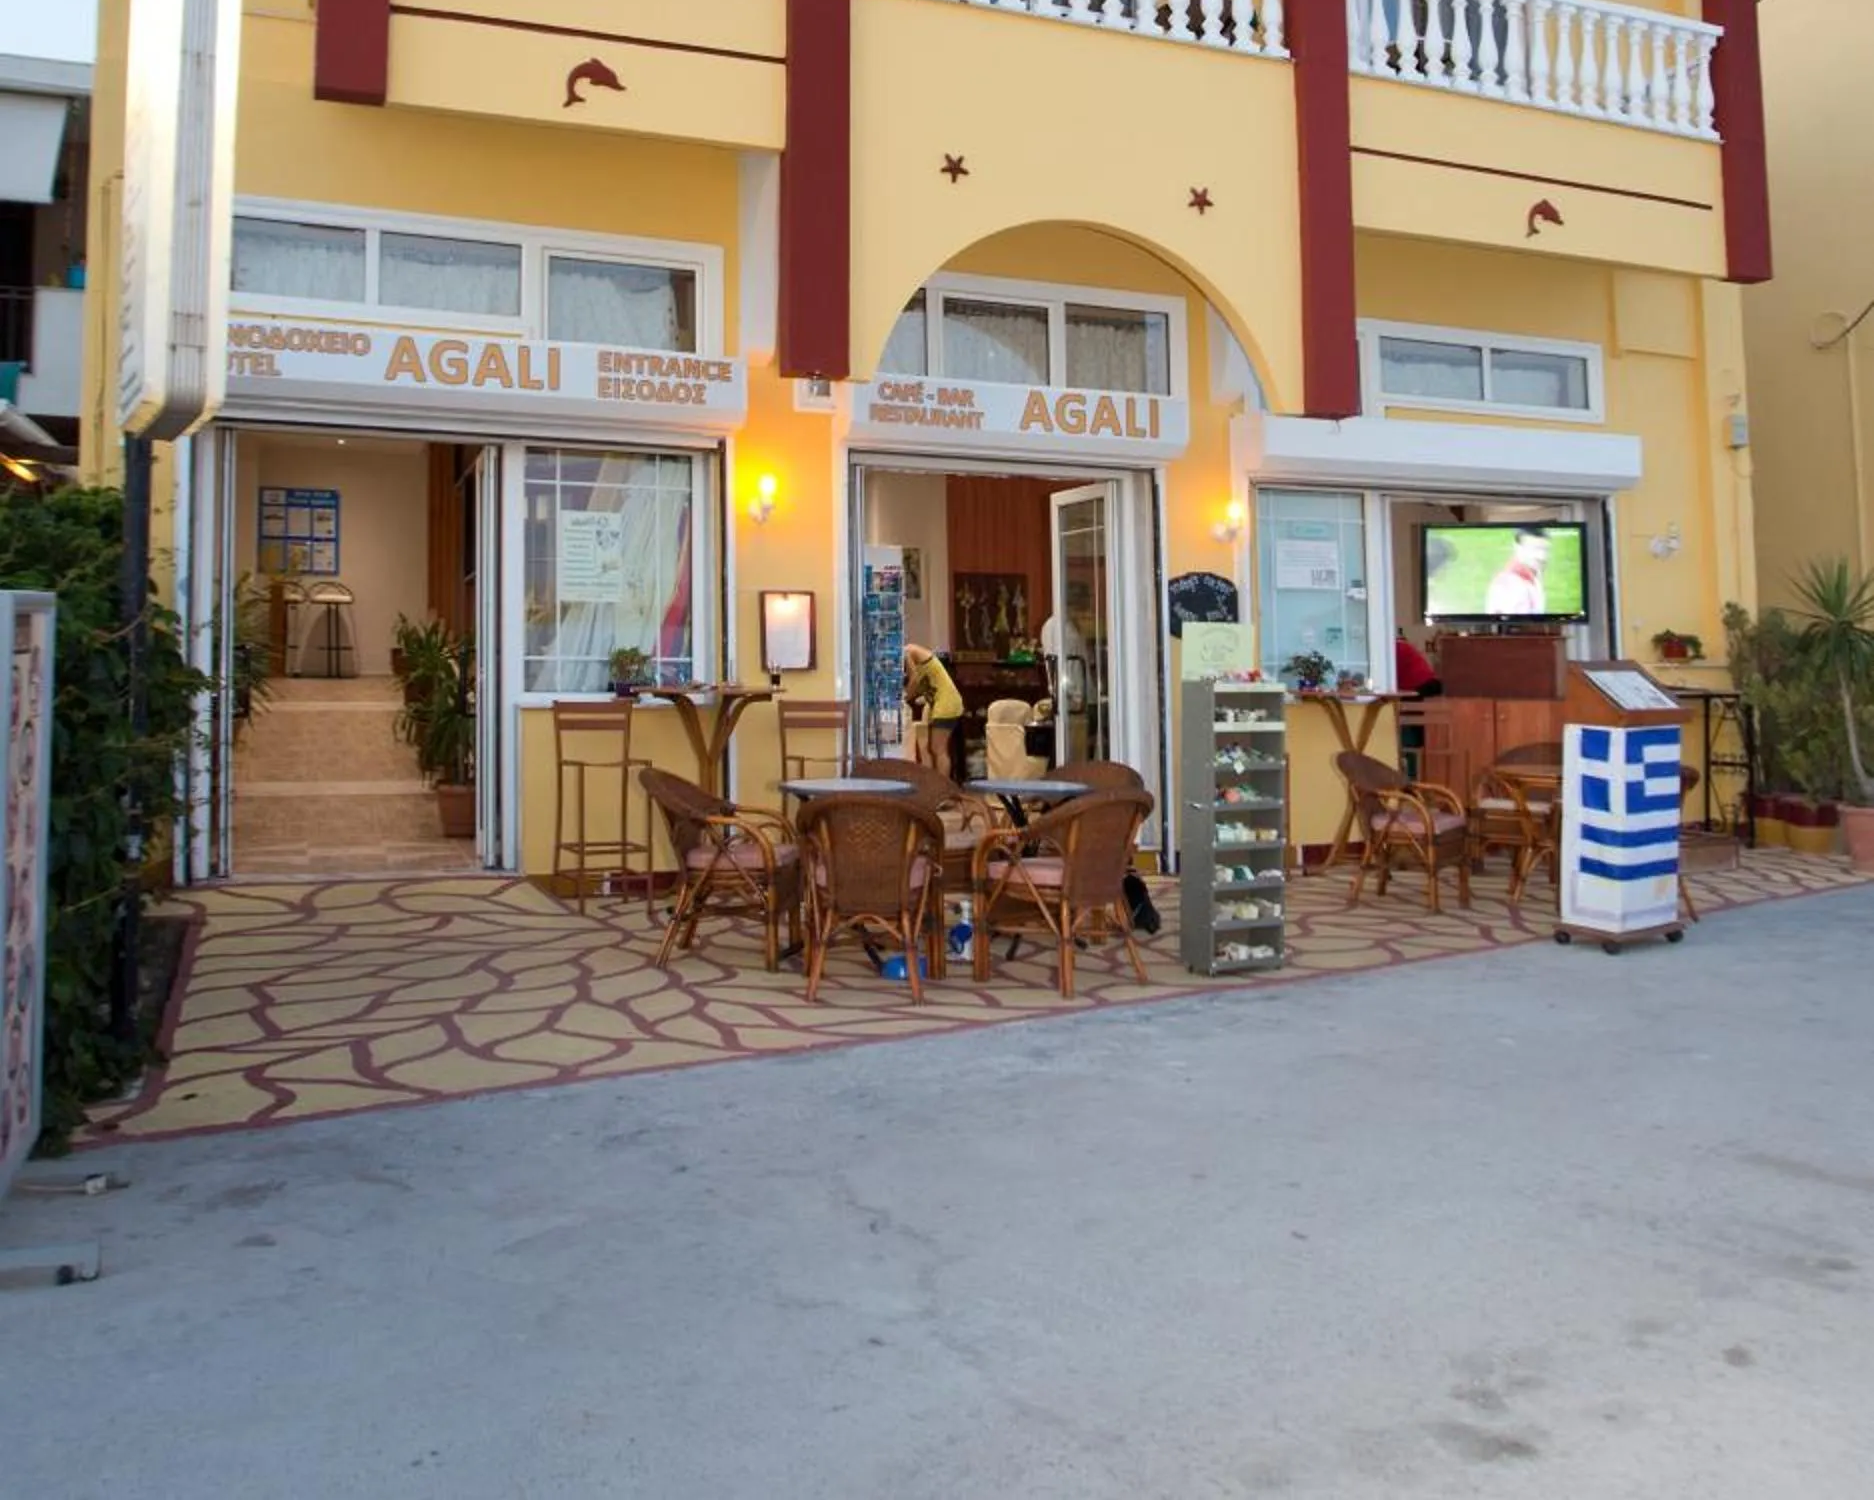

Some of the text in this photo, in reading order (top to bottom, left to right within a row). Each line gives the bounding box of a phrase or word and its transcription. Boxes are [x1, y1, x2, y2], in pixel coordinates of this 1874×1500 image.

[227, 323, 372, 357] ΝΟΔΟΧΕΙΟ
[227, 351, 282, 376] TEL
[384, 335, 562, 391] AGALI
[597, 350, 733, 382] ENTRANCE
[597, 376, 707, 405] ΕΙΣΟΔΟΣ
[937, 387, 975, 407] BAR
[869, 403, 985, 430] RESTAURANT
[1019, 389, 1160, 439] AGALI
